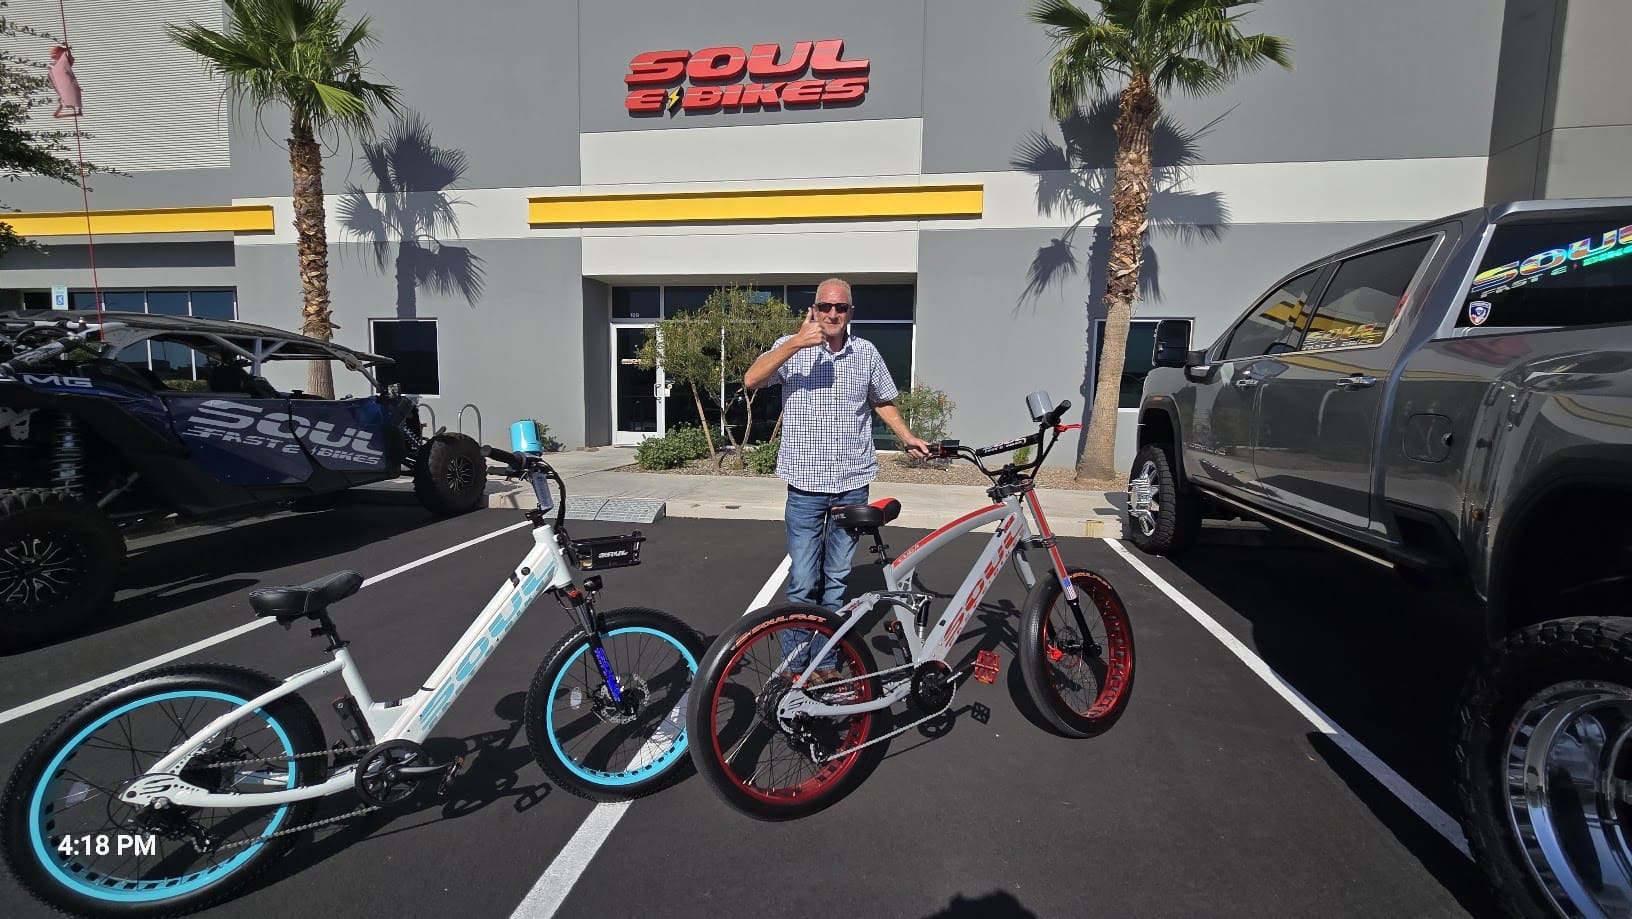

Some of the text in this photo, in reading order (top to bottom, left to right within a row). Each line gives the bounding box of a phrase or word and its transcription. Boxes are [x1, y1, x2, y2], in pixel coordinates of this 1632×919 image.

[624, 40, 870, 86] SOUL
[1480, 273, 1544, 298] FAST
[182, 425, 285, 449] FAST
[189, 399, 384, 456] SOUL
